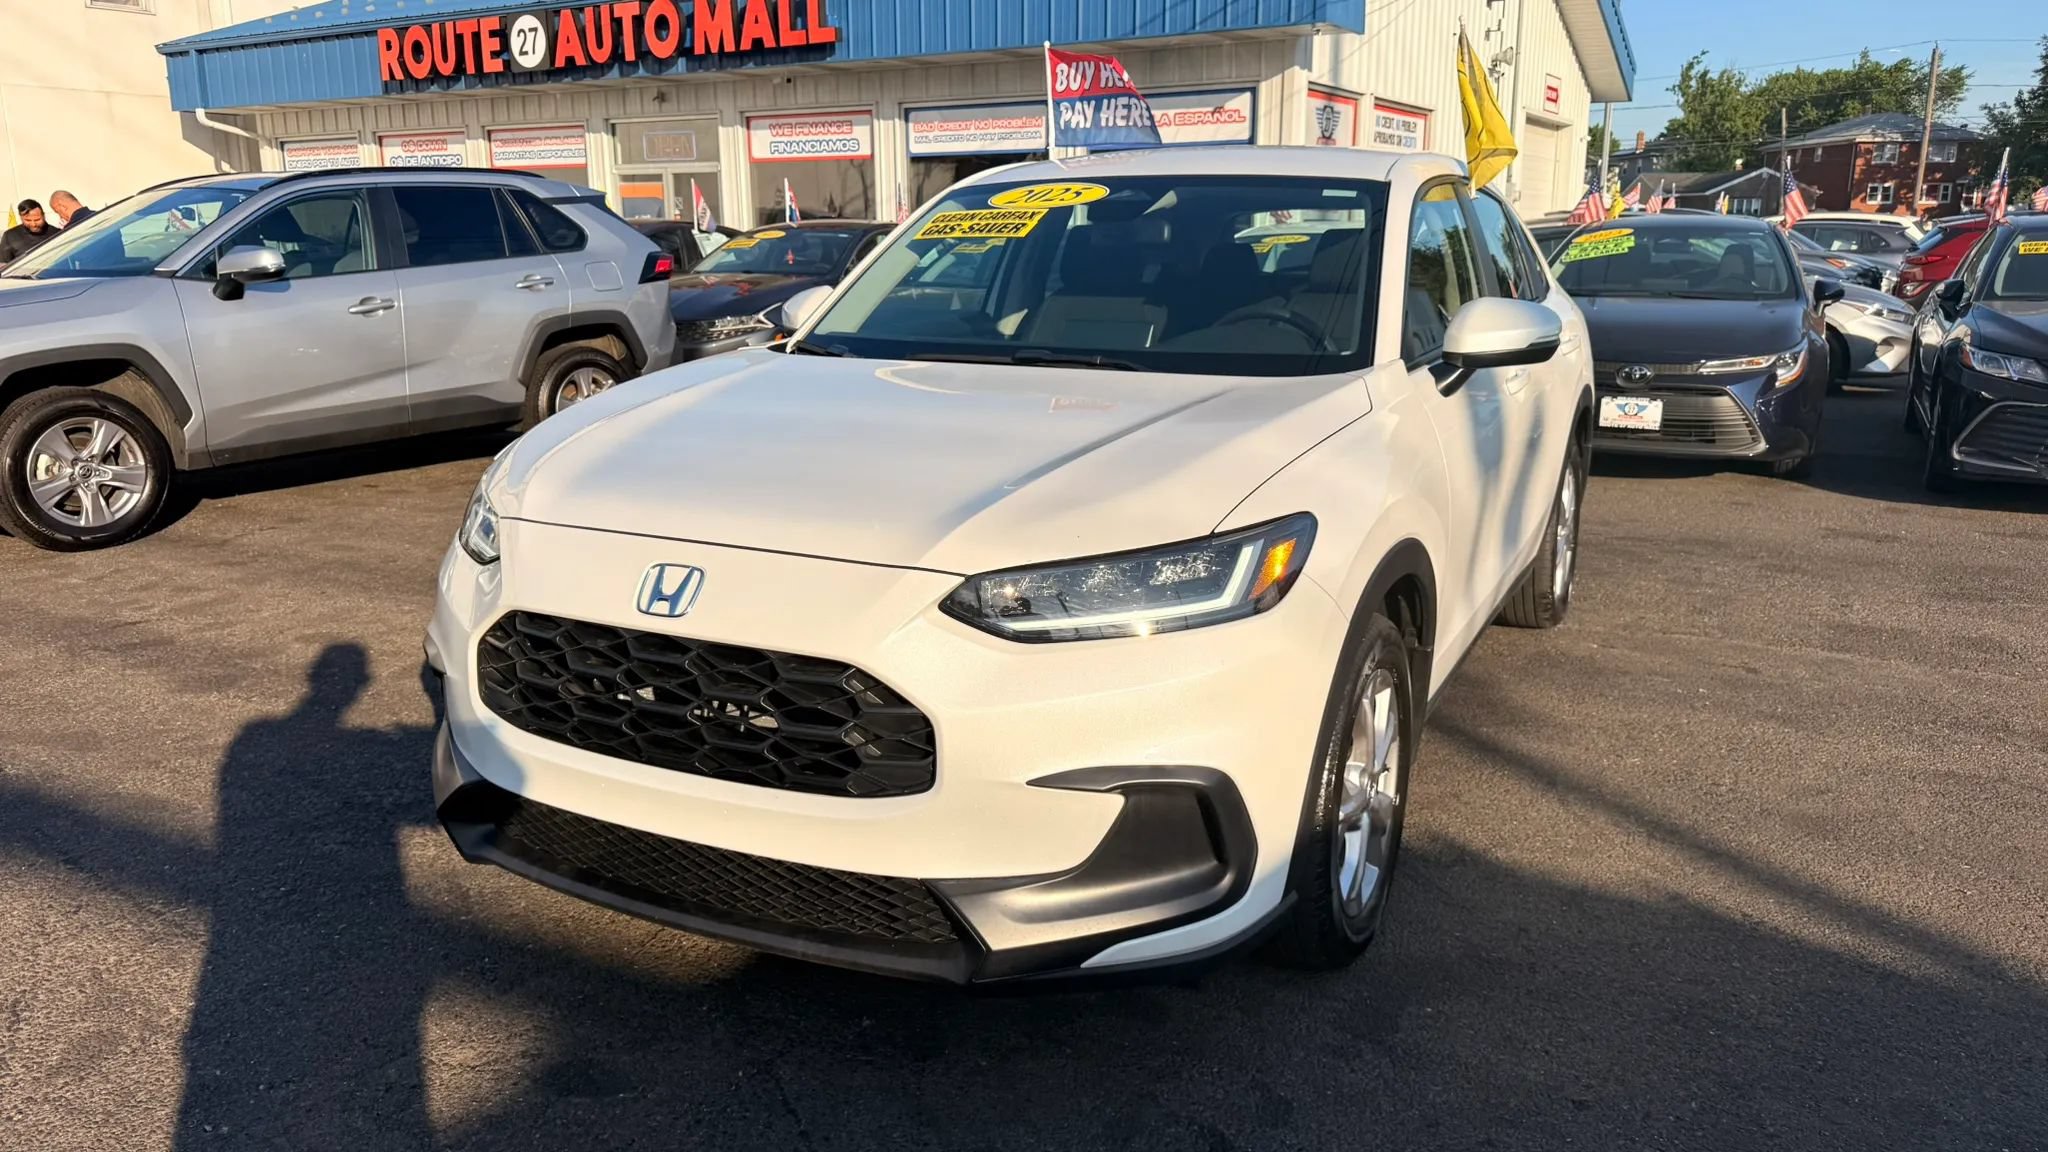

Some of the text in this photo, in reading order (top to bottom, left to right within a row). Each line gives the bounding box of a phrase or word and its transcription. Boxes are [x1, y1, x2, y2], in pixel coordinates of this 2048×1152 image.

[376, 0, 838, 82] ROUTE 27 AUTO MALL
[1055, 61, 1095, 93] BUY
[1060, 96, 1151, 130] PAY HERE
[1174, 106, 1247, 126] ESPAÑOL
[768, 120, 853, 137] WE FINANCE
[913, 118, 1043, 133] BAD CREDIT NO PROBLEM
[416, 138, 449, 152] DOWN
[769, 138, 860, 154] FINANCIAMOS
[406, 155, 419, 167] DE
[419, 153, 463, 167] ANTICIPO
[1004, 187, 1094, 205] 2025
[931, 209, 1043, 224] CLEAN CARFAX
[921, 222, 1028, 237] GAS-SAVER
